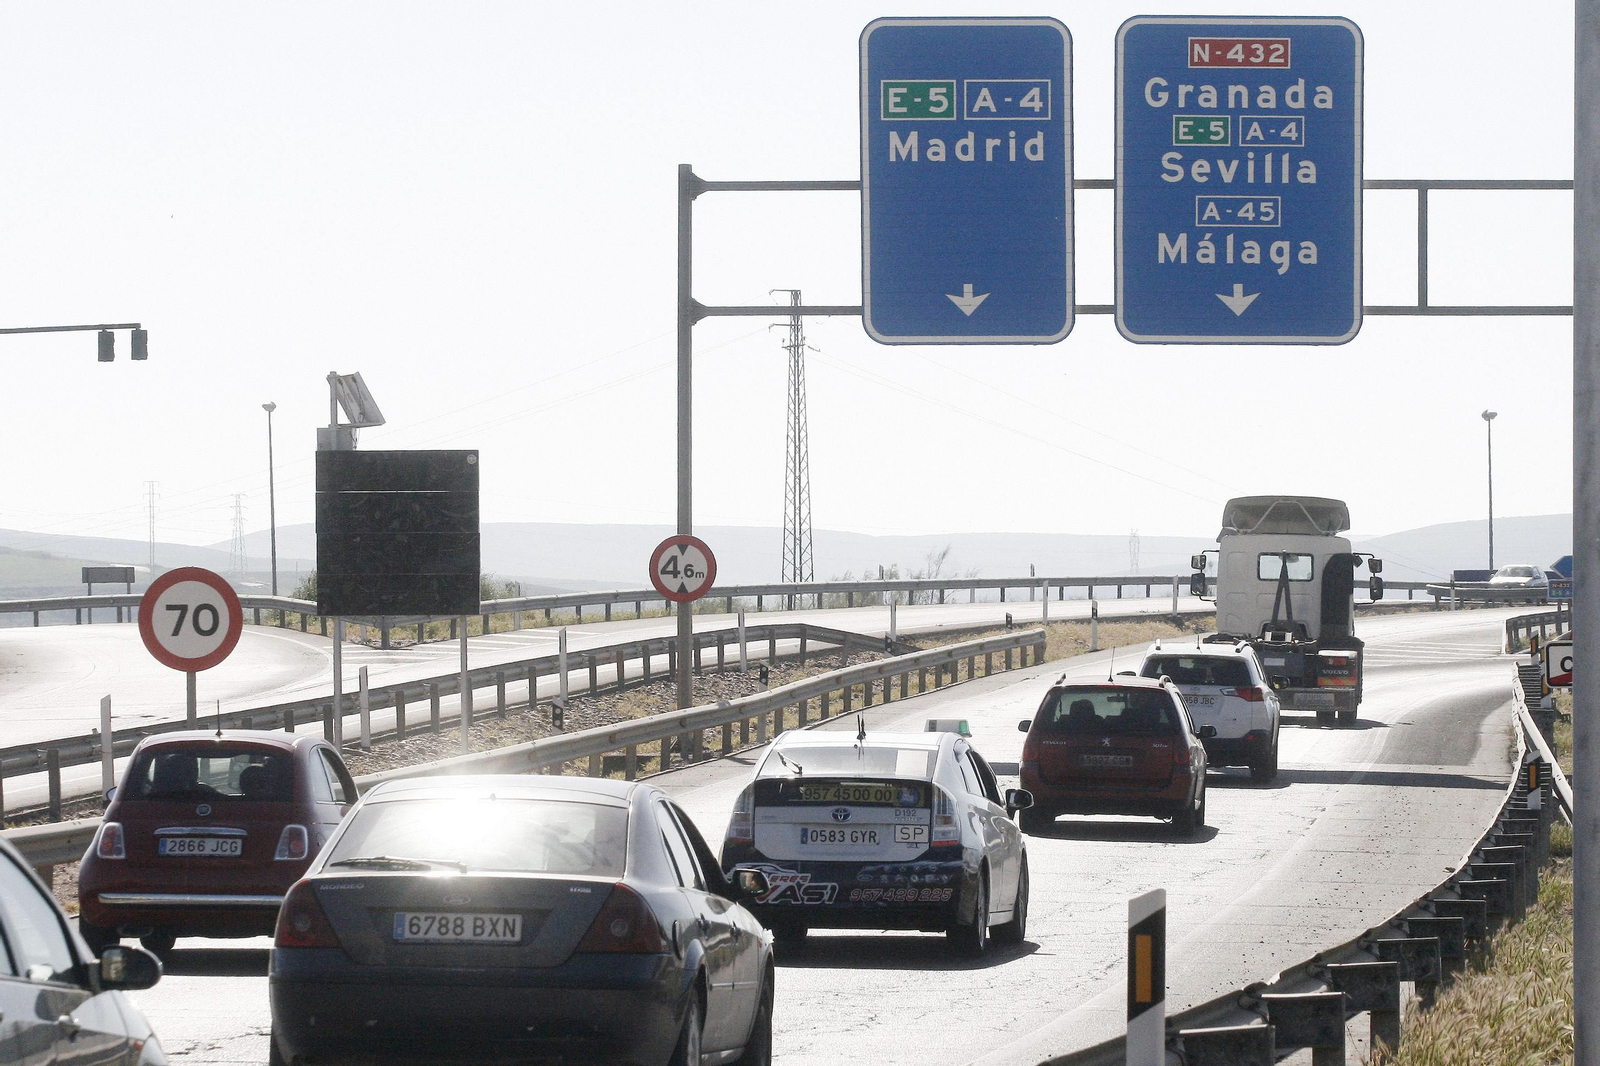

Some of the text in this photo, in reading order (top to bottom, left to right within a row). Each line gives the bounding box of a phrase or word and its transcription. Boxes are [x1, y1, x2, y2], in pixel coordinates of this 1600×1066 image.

[1192, 41, 1286, 64] N-432
[886, 86, 1044, 114] E-5 A-4
[1144, 76, 1335, 110] Granada
[1178, 121, 1299, 142] E-5 A-4
[888, 129, 1046, 163] Madrid
[1160, 151, 1318, 185] Sevilla
[1202, 202, 1276, 222] A-45
[1157, 232, 1318, 275] Málaga
[165, 603, 219, 636] 70
[1199, 697, 1215, 705] JBC
[804, 787, 829, 800] 957
[833, 788, 850, 801] 45
[853, 788, 871, 801] 00
[874, 789, 892, 802] 00
[810, 830, 877, 844] 0583 GYR
[900, 827, 924, 840] SP
[168, 839, 238, 853] 2866 JCG
[850, 888, 953, 902] 957 429 225
[408, 915, 517, 938] 6788 BXN
